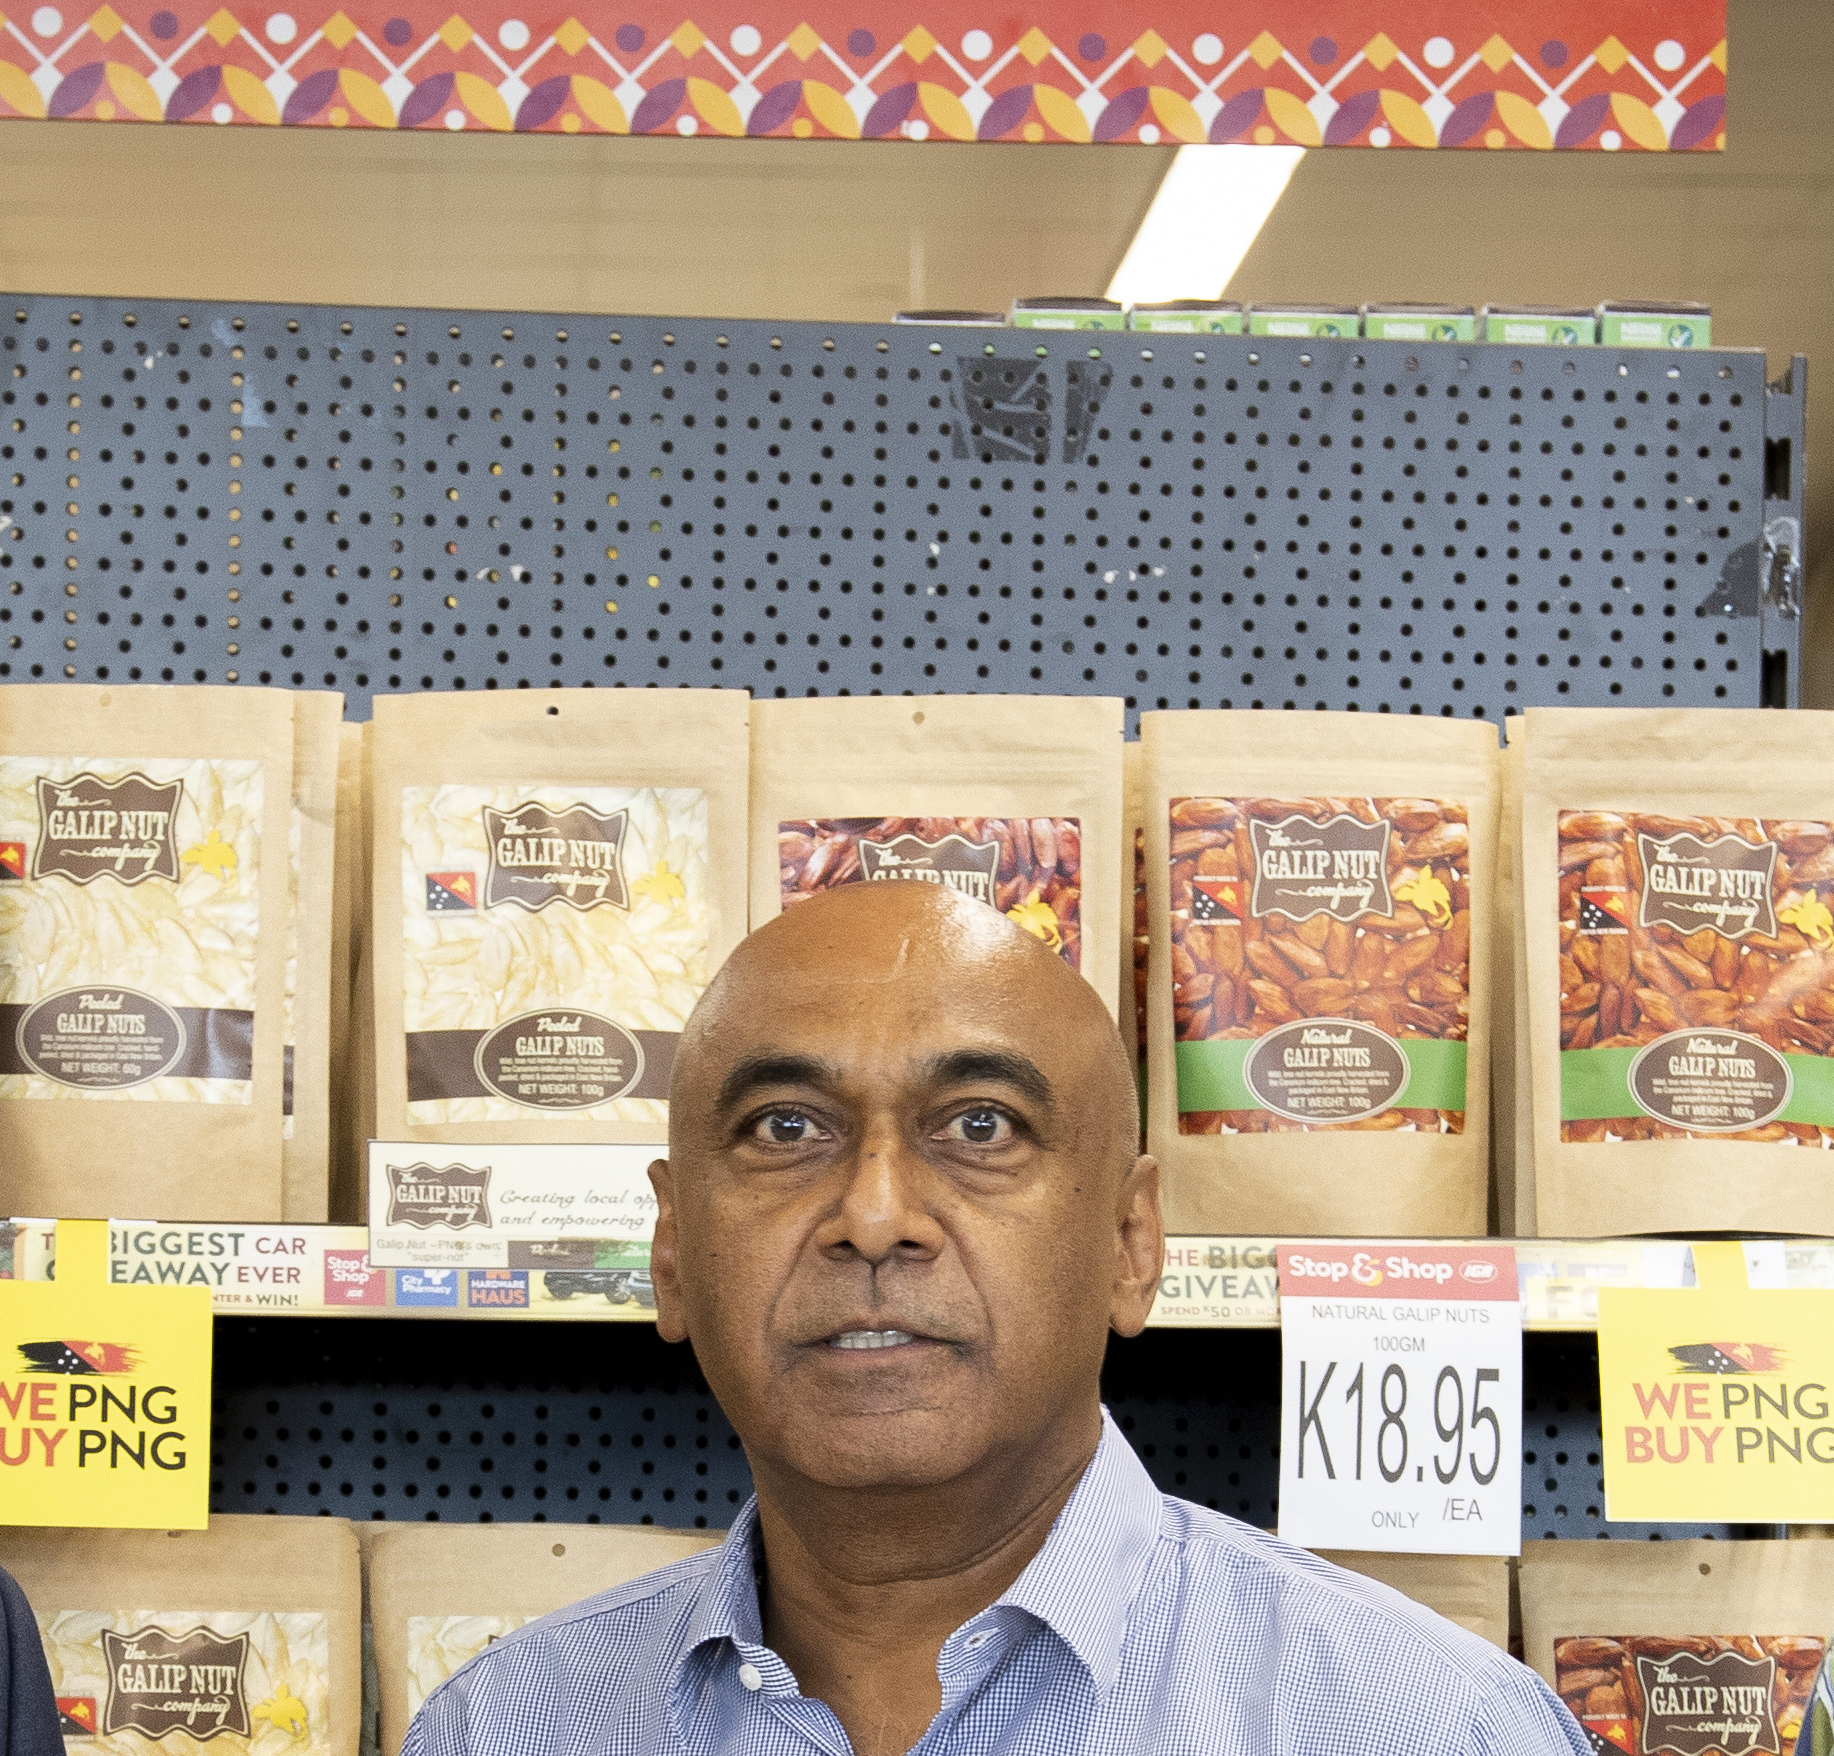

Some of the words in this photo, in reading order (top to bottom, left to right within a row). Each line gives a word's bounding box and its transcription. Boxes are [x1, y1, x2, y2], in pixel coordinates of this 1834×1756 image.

[49, 810, 117, 840] GALIP
[119, 810, 169, 840] NUT
[498, 838, 567, 867] GALIP
[568, 839, 616, 870] NUT
[1263, 850, 1332, 879] GALIP
[1332, 850, 1380, 879] NUT
[1650, 864, 1716, 896] GALIP
[1718, 868, 1766, 900] NUT
[57, 1013, 106, 1034] GALIP
[106, 1013, 146, 1035] NUTS
[516, 1036, 564, 1056] GALIP
[565, 1036, 605, 1056] NUTS
[1284, 1048, 1330, 1067] GALIP
[1333, 1048, 1371, 1067] NUTS
[1669, 1056, 1715, 1076] GALIP
[1717, 1057, 1756, 1078] NUTS
[396, 1184, 446, 1203] GALIP
[447, 1185, 483, 1203] NUT
[500, 1189, 575, 1208] Creating
[584, 1189, 629, 1204] local
[500, 1211, 536, 1224] and
[541, 1213, 645, 1231] empowering
[255, 1237, 307, 1255] CAR
[237, 1266, 301, 1284] EVER
[327, 1256, 360, 1272] Stop
[1288, 1255, 1348, 1283] Stop
[1385, 1257, 1454, 1284] Shop
[256, 1294, 299, 1306] WIN!
[471, 1289, 526, 1305] HAUS
[1161, 1306, 1200, 1316] SPEND
[1312, 1305, 1388, 1321] NATURAL
[1393, 1307, 1440, 1322] GALIP
[1446, 1309, 1490, 1324] NUTS
[1373, 1336, 1425, 1352] 100GM
[69, 1384, 177, 1424] PNG
[1633, 1383, 1713, 1421] WE
[1723, 1384, 1830, 1420] PNG
[1297, 1361, 1503, 1485] K18.95
[78, 1430, 187, 1470] PNG
[1625, 1427, 1722, 1465] BUY
[1371, 1510, 1419, 1530] ONLY
[1443, 1498, 1483, 1525] /EA
[118, 1664, 187, 1693] GALIP
[189, 1665, 236, 1695] NUT
[1651, 1687, 1718, 1716] GALIP
[1721, 1686, 1766, 1716] NUT
